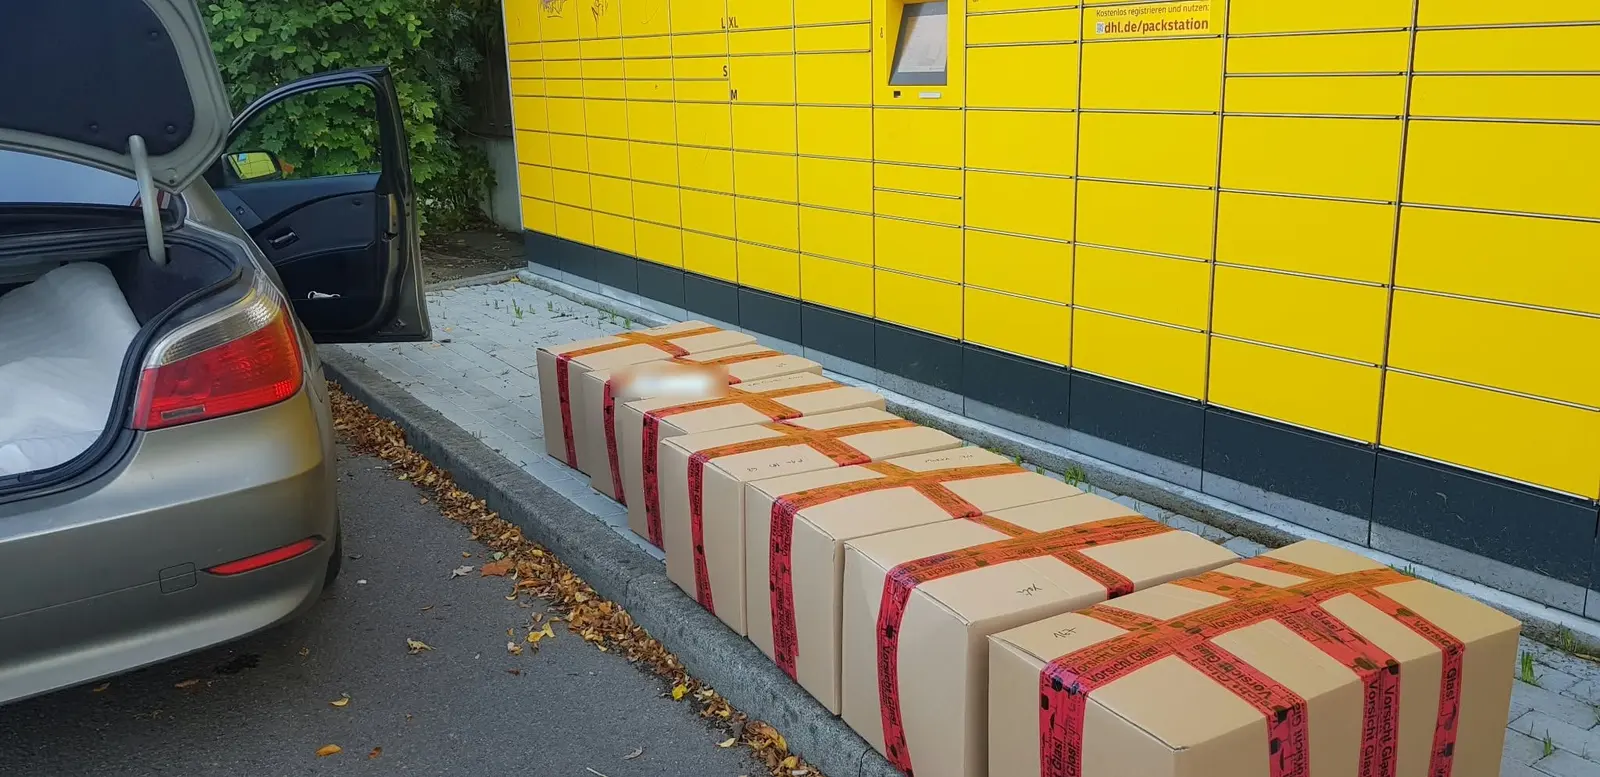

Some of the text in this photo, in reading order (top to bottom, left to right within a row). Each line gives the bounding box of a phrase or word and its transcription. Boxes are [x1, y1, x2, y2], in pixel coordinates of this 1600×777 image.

[721, 17, 726, 29] L
[729, 17, 738, 28] XL
[1096, 4, 1210, 17] Kostenlos registrieren und nutzen:
[1104, 18, 1209, 34] dhl.de/packstation
[722, 65, 728, 77] S
[730, 89, 738, 101] M
[1311, 609, 1345, 632] Glas!
[1066, 647, 1114, 676] Vorsicht
[1112, 639, 1138, 657] Glas!
[1086, 658, 1133, 682] Vorsicht
[1129, 644, 1161, 662] Glas!
[1414, 620, 1459, 702] Vorsicht Glas!
[1220, 662, 1273, 700] Vorsicht
[1362, 679, 1379, 777] Vorsicht Glas
[1379, 685, 1396, 777] Vorsicht Glas
[1052, 736, 1063, 771] Glas!
